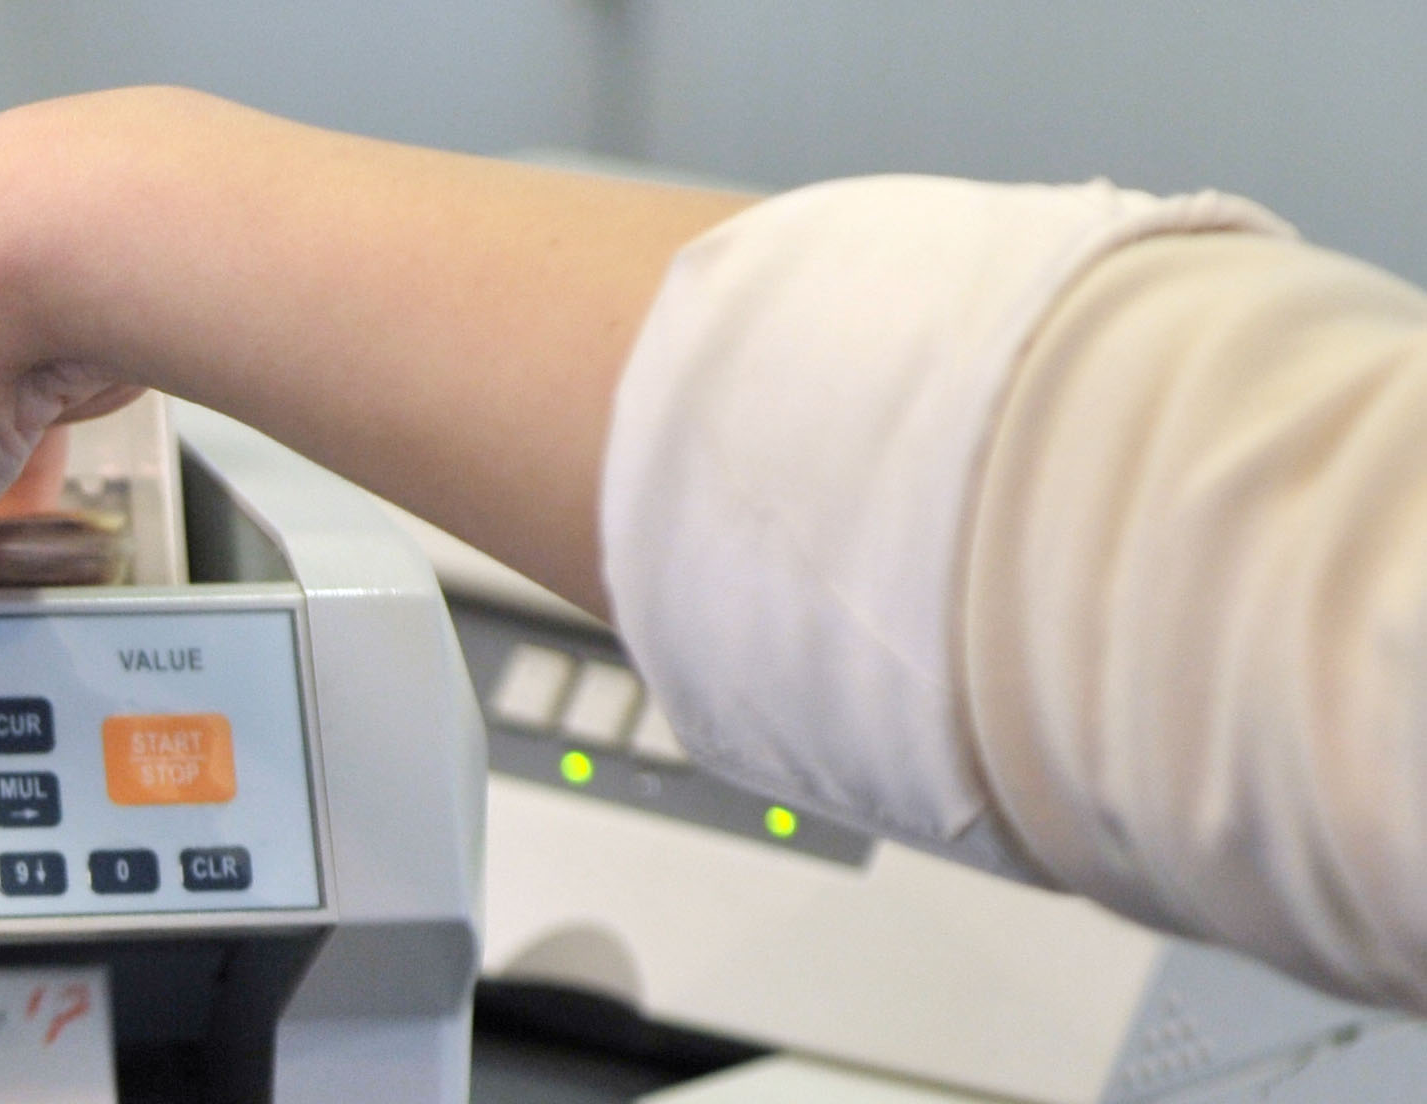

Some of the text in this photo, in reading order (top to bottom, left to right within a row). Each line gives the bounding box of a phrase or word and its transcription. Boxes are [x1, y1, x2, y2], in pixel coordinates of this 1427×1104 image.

[119, 648, 204, 672] VALUE
[130, 730, 204, 754] START
[0, 776, 49, 799] MUL
[140, 763, 201, 788] STOP
[116, 858, 129, 883] 0
[192, 855, 238, 880] CLR
